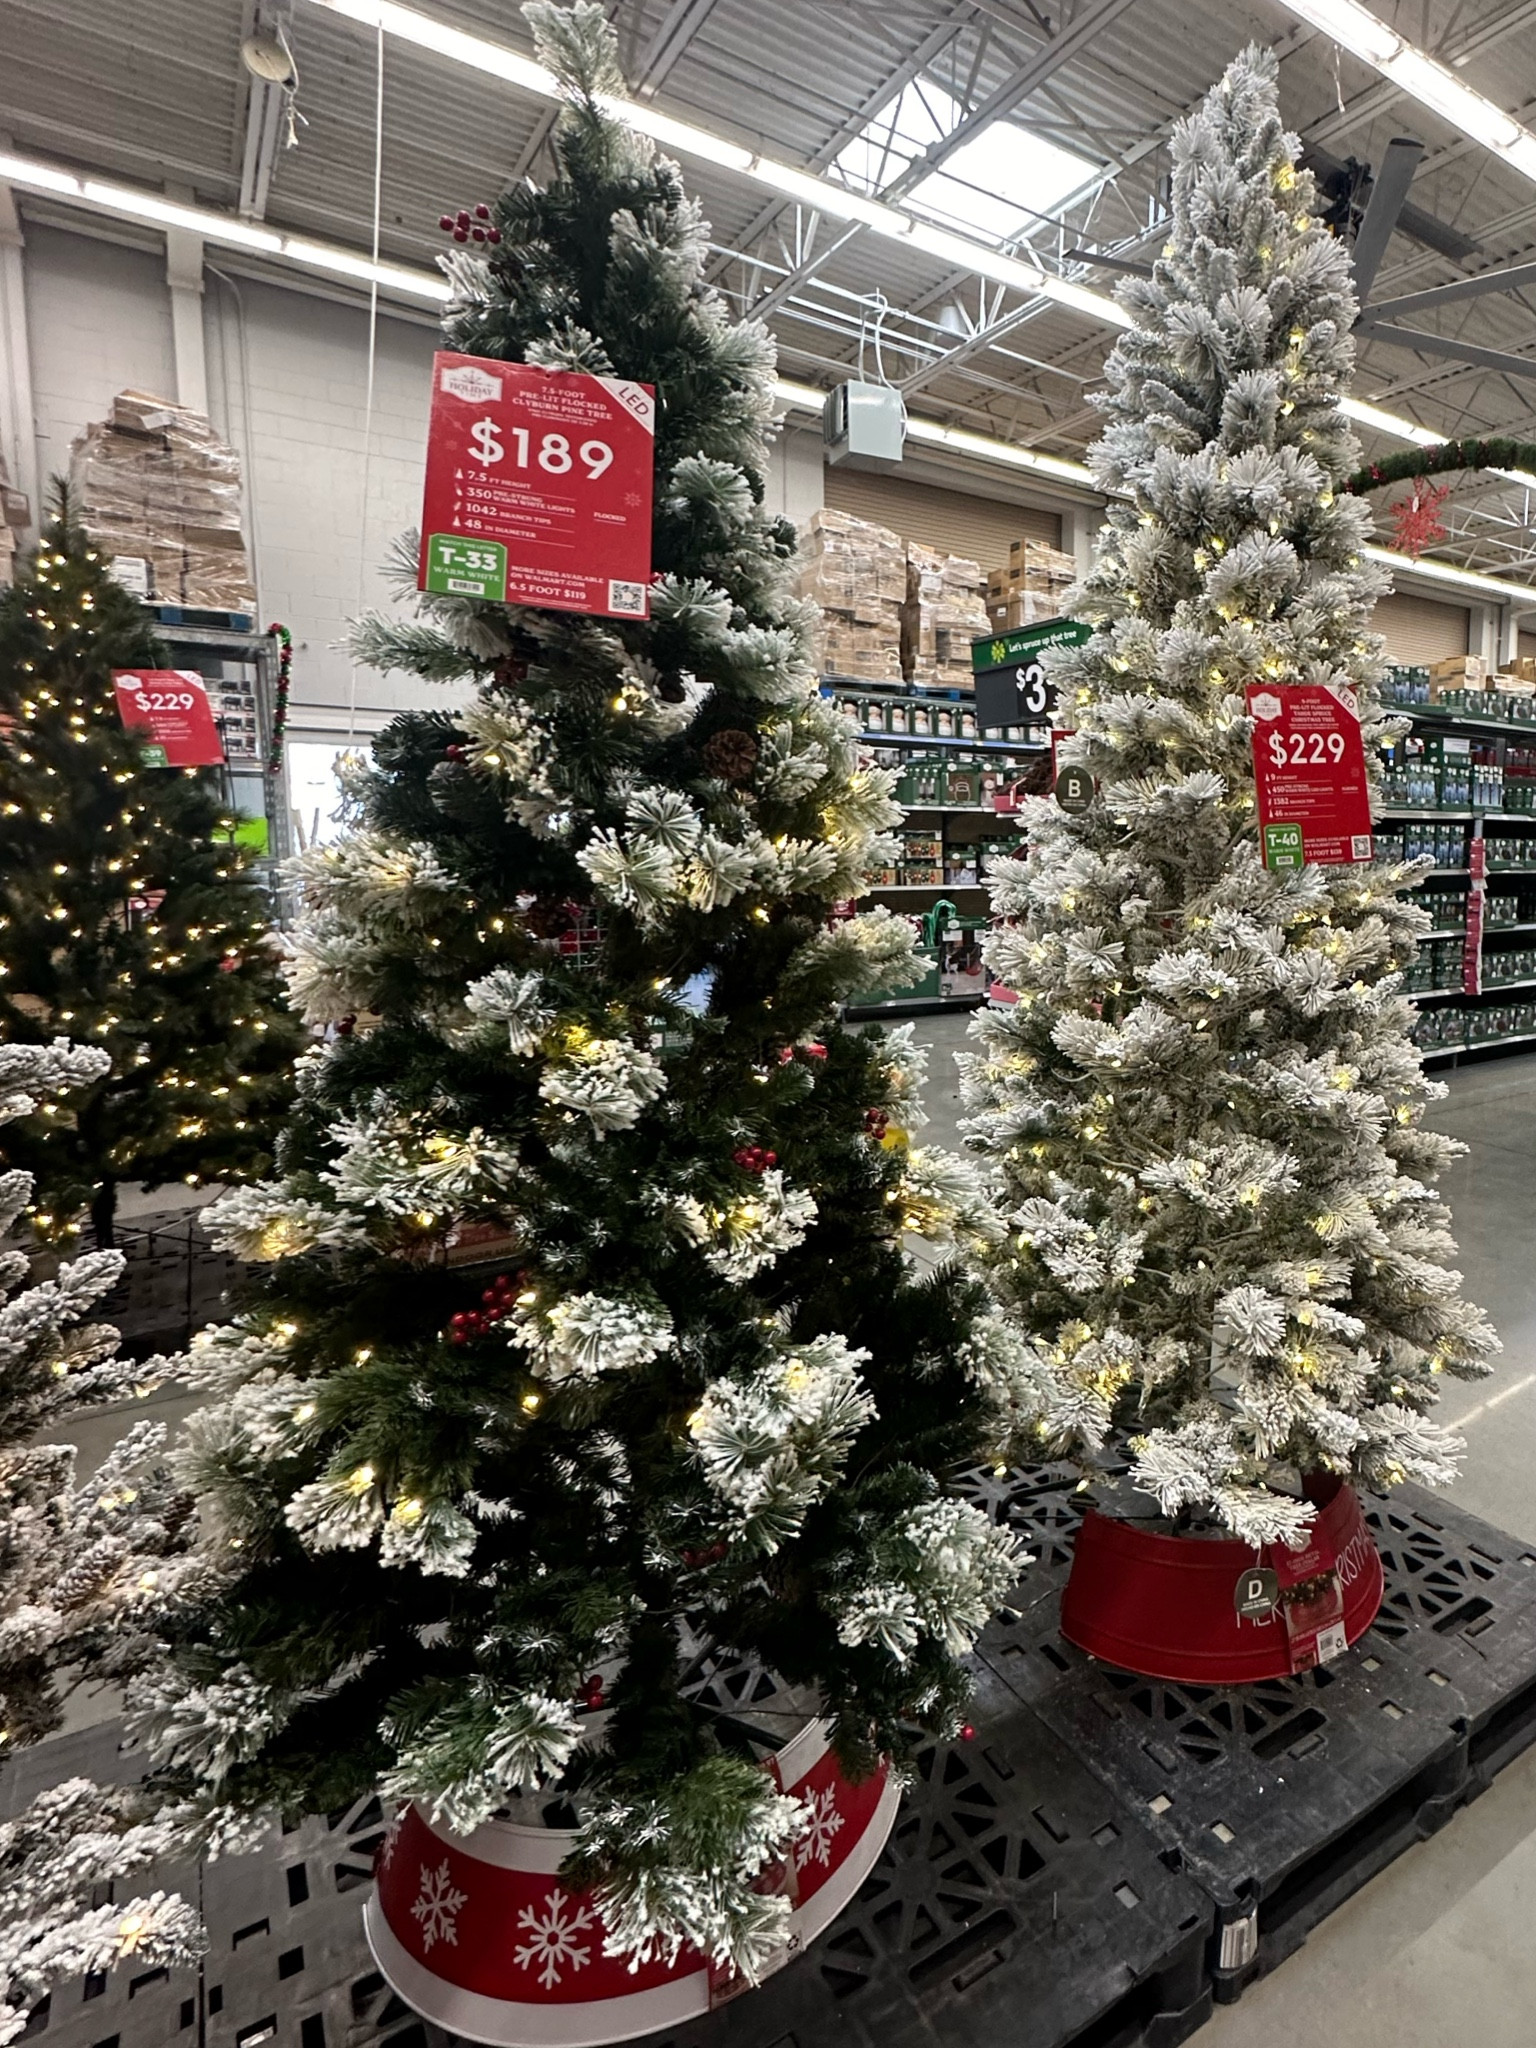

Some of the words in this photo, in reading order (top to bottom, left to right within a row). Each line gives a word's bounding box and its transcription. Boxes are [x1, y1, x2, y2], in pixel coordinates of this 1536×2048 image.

[449, 382, 492, 396] HOLIDAY
[541, 386, 586, 399] 7.5-FOOT
[512, 397, 560, 411] CLYBURN
[561, 405, 585, 416] PINE
[586, 409, 613, 420] TREE
[520, 391, 560, 403] PRE-LIT
[561, 398, 607, 411] FLOCKED
[619, 387, 649, 415] LED
[467, 416, 614, 480] $189
[467, 470, 487, 482] 7.5
[501, 479, 531, 489] HEIGHT
[467, 487, 492, 499] 350
[466, 503, 497, 516] 1042
[500, 511, 532, 522] BRANCH
[534, 516, 552, 525] TIPS
[520, 500, 546, 509] WHITE
[546, 504, 576, 513] LIGHTS
[464, 518, 482, 529] 48
[495, 526, 537, 538] DIAMETER
[438, 546, 498, 572] T-33
[433, 566, 465, 577] WARM
[466, 571, 501, 582] WHITE
[511, 565, 535, 574] MORE
[537, 569, 560, 577] SIZES
[561, 573, 604, 584] AVAILABLE
[524, 574, 586, 588] WALMART.COM
[509, 582, 526, 591] 6.5
[528, 584, 561, 596] FOOT
[563, 589, 587, 600] $119
[1009, 642, 1022, 653] Let's
[1022, 640, 1042, 651] spruce
[1042, 637, 1050, 646] up
[1050, 633, 1064, 644] that
[1063, 631, 1077, 639] tree
[1016, 664, 1046, 713] $3
[135, 691, 194, 712] $229
[1337, 689, 1355, 708] LED
[1269, 730, 1345, 768] $229
[1068, 779, 1081, 797] B
[1268, 832, 1299, 847] T-40
[1248, 1580, 1263, 1600] D
